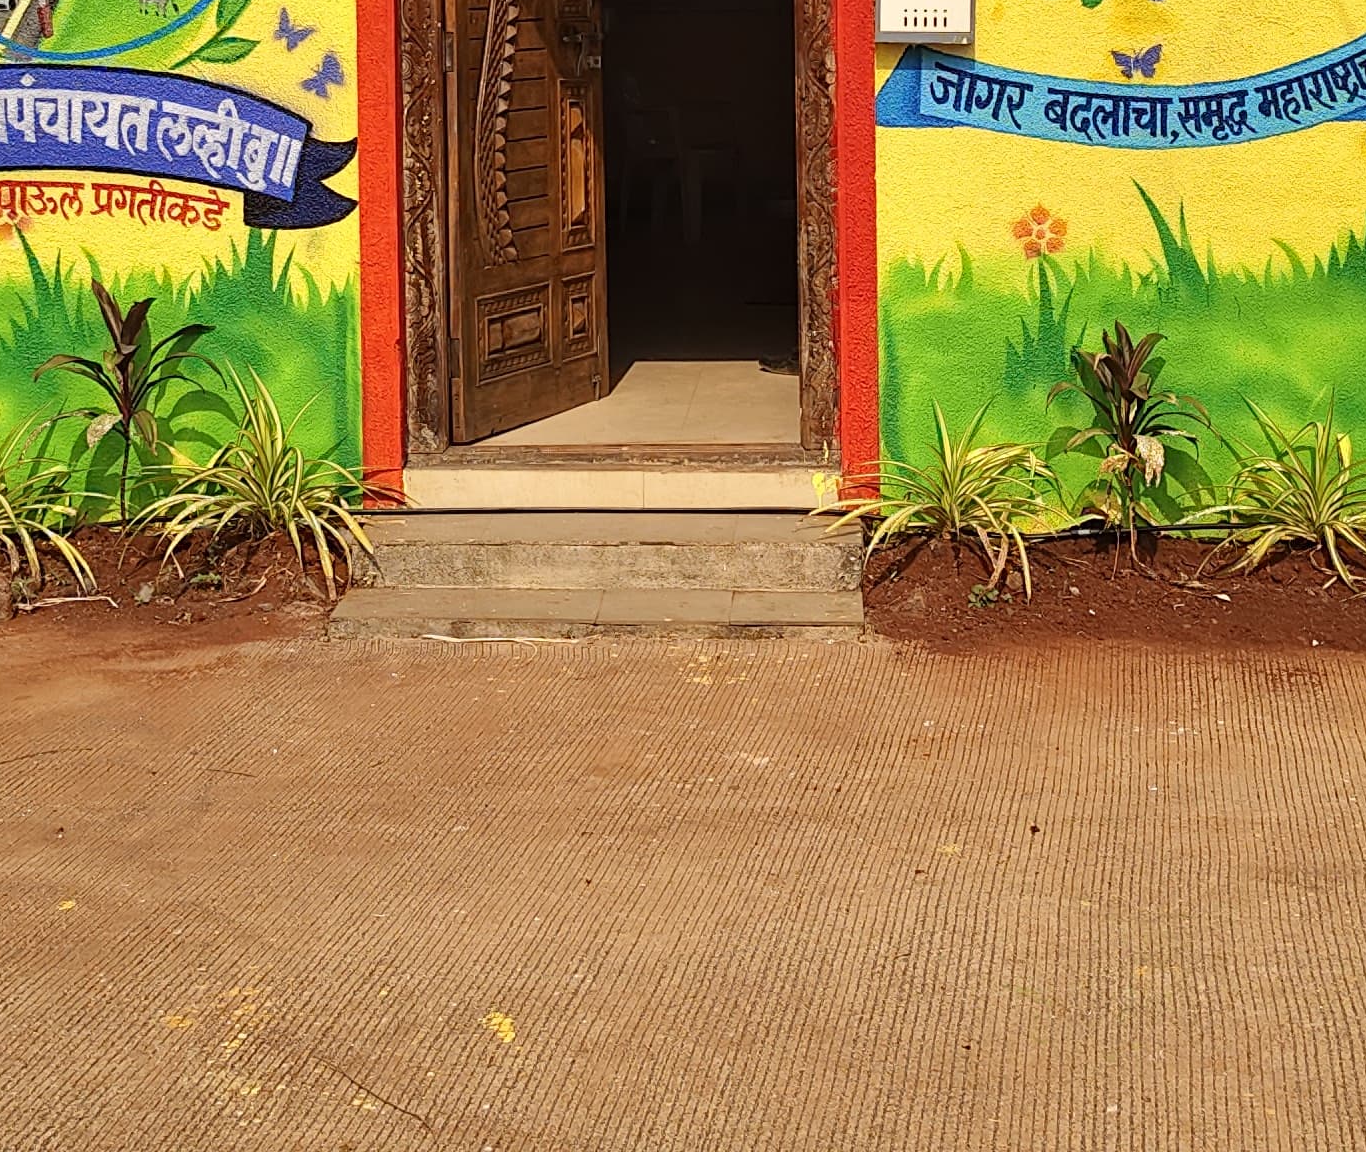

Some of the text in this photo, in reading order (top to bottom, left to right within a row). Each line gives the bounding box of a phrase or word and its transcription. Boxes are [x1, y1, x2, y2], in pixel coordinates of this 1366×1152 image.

[930, 62, 1033, 130] जागर
[156, 98, 251, 180] लव्ही
[91, 179, 230, 231] प्रगतीकडे
